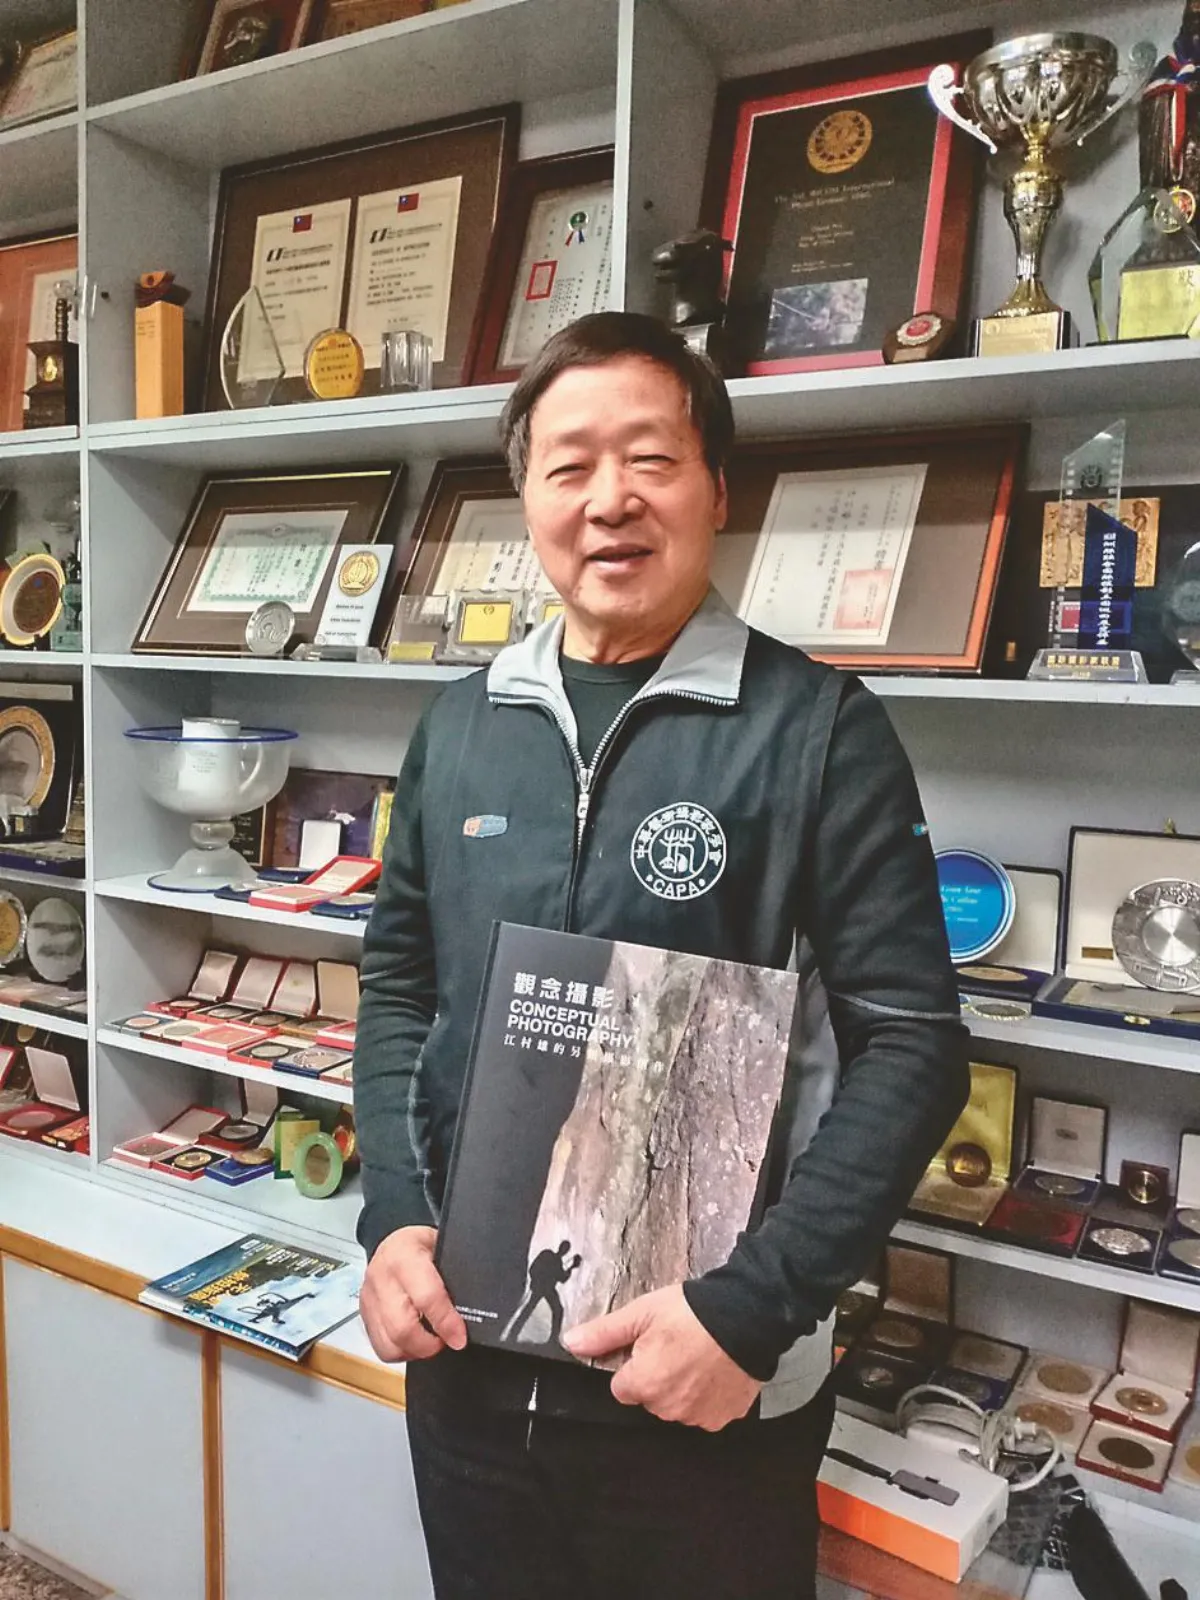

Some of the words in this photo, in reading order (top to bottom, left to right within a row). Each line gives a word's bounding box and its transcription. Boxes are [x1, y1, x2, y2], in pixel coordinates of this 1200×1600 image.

[653, 879, 700, 898] CAPA
[513, 972, 615, 1009] 觀念攝影
[507, 1014, 634, 1049] PHOTOGRAPHY
[510, 999, 621, 1032] CONCEPTUAL
